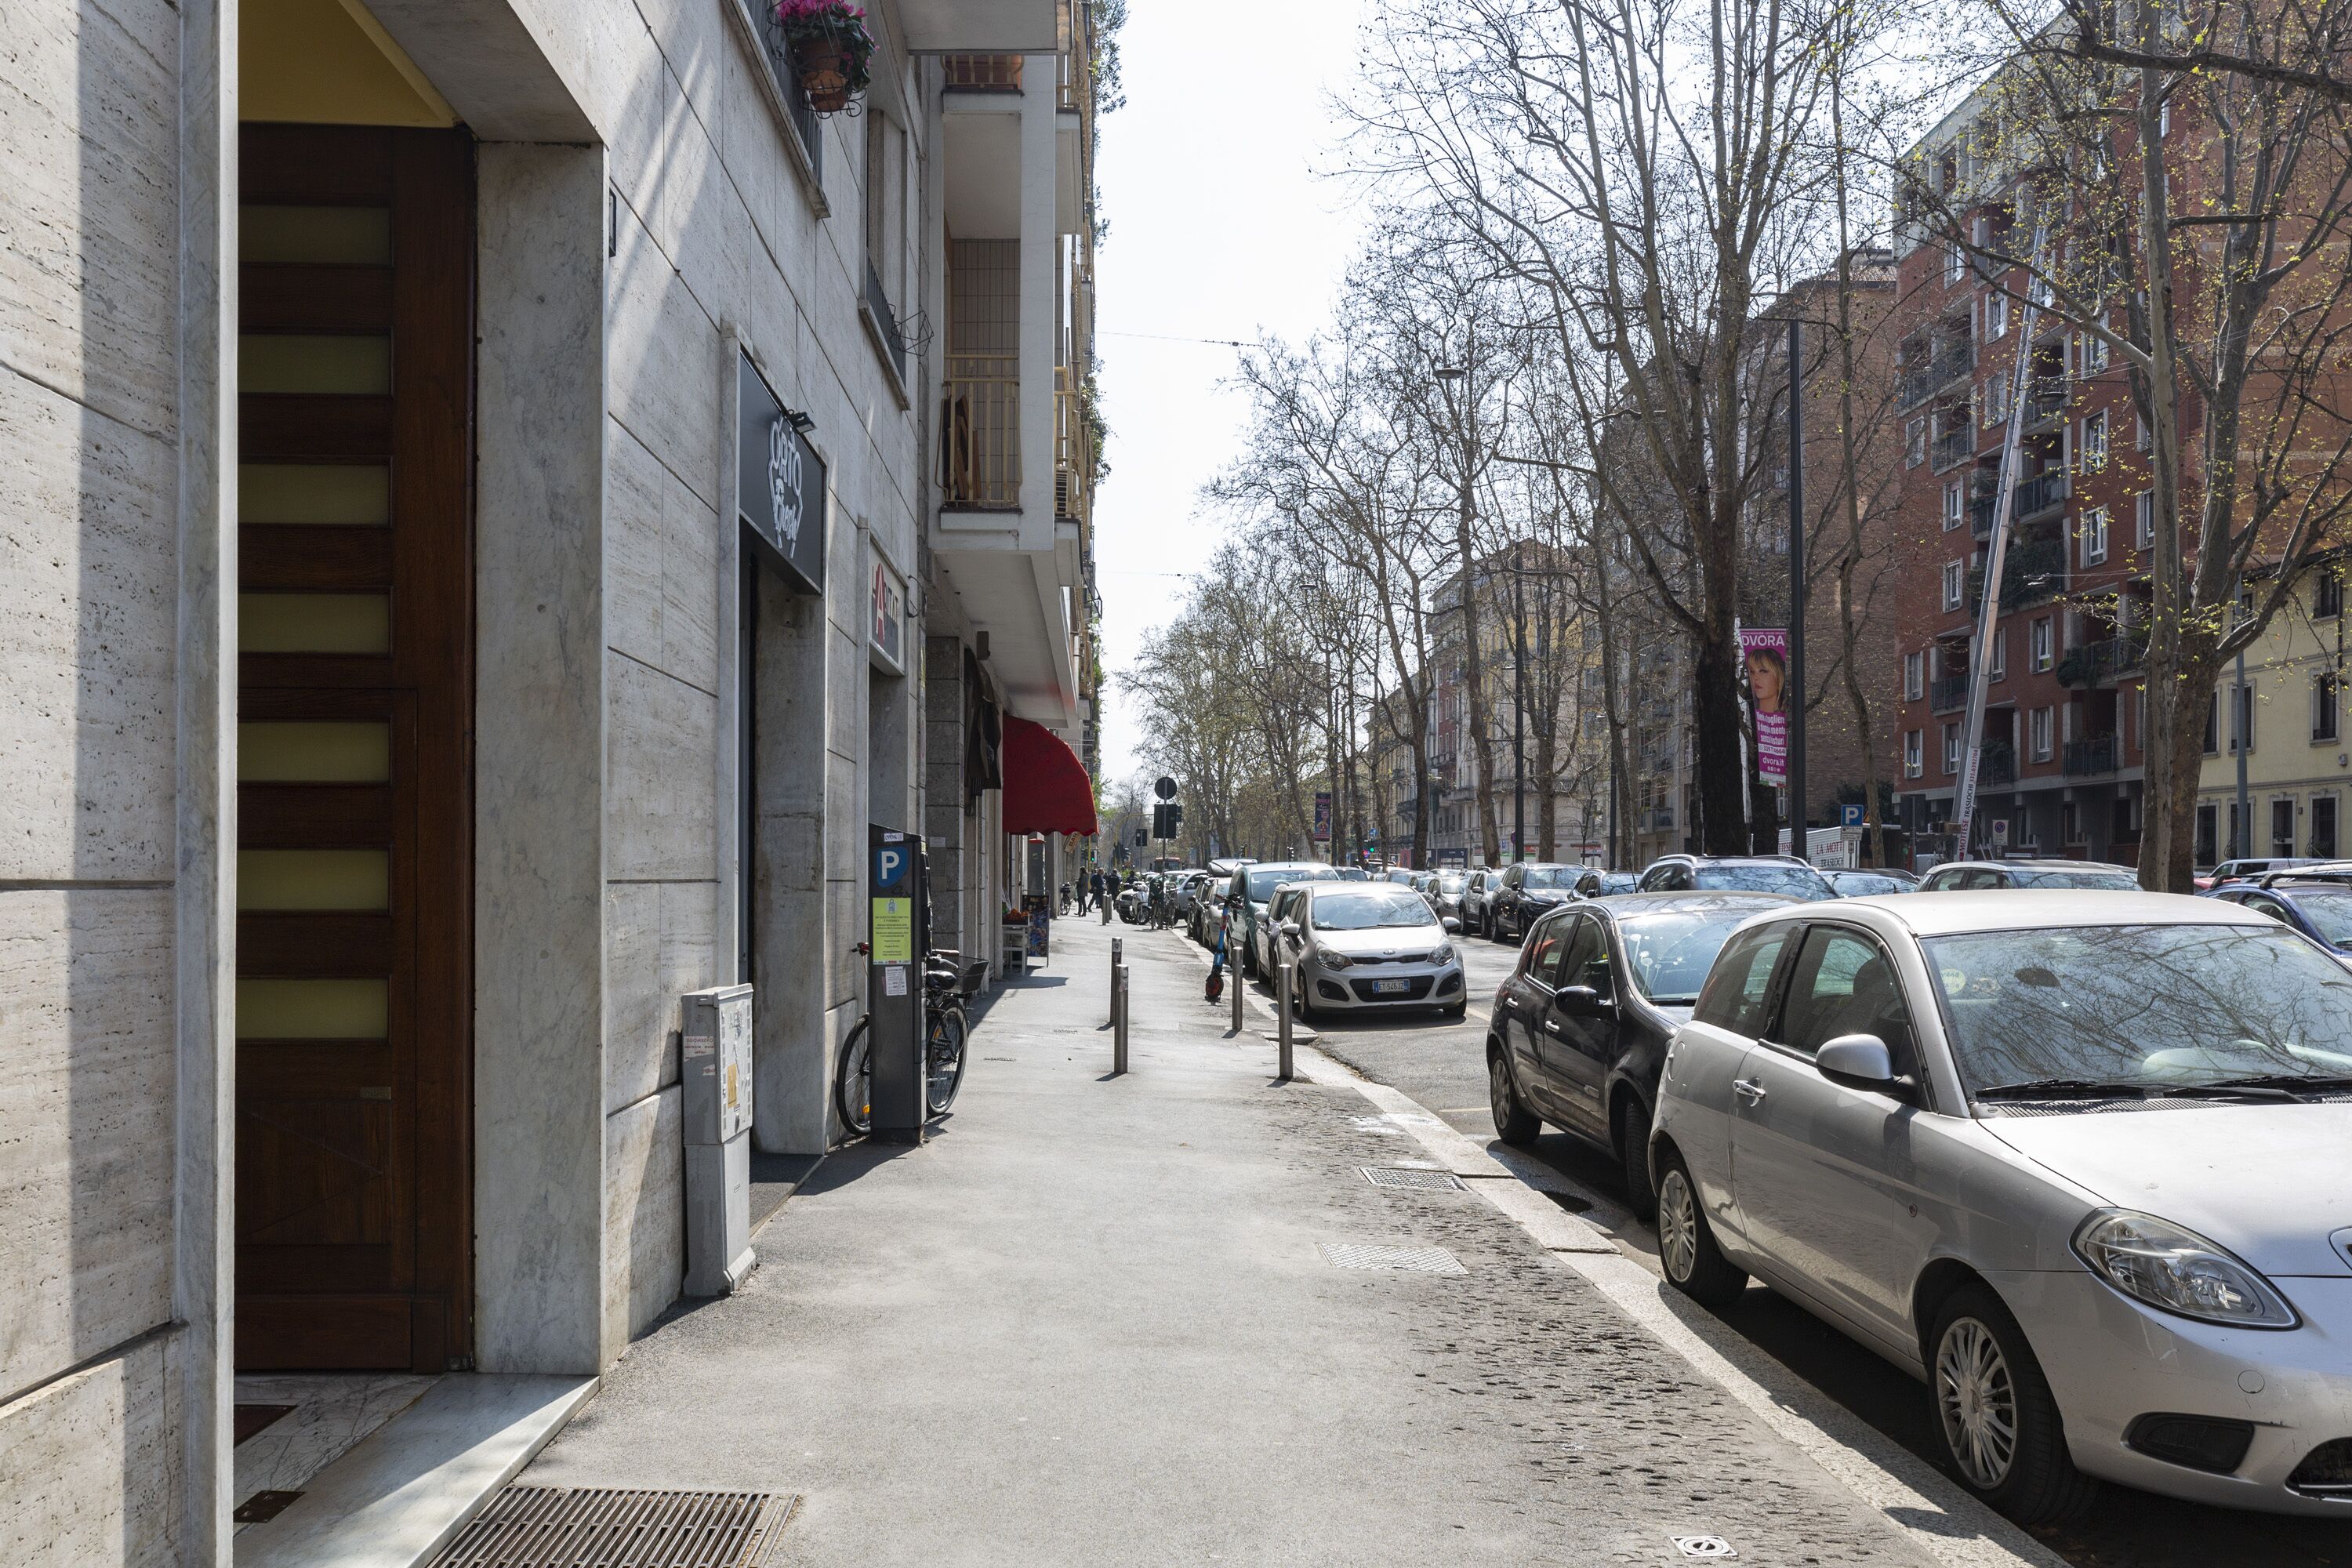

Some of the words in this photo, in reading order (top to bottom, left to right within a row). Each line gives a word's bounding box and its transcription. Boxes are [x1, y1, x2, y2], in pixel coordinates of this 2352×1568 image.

[770, 421, 802, 496] ORTO
[1741, 635, 1785, 646] DVORA
[1762, 755, 1784, 767] dvora.it
[1964, 784, 1974, 818] TRASLOCHI
[1846, 807, 1859, 824] P
[1959, 819, 1969, 852] MOTTESE
[1817, 844, 1824, 855] LA
[1825, 841, 1843, 853] MOTT
[881, 851, 899, 880] P
